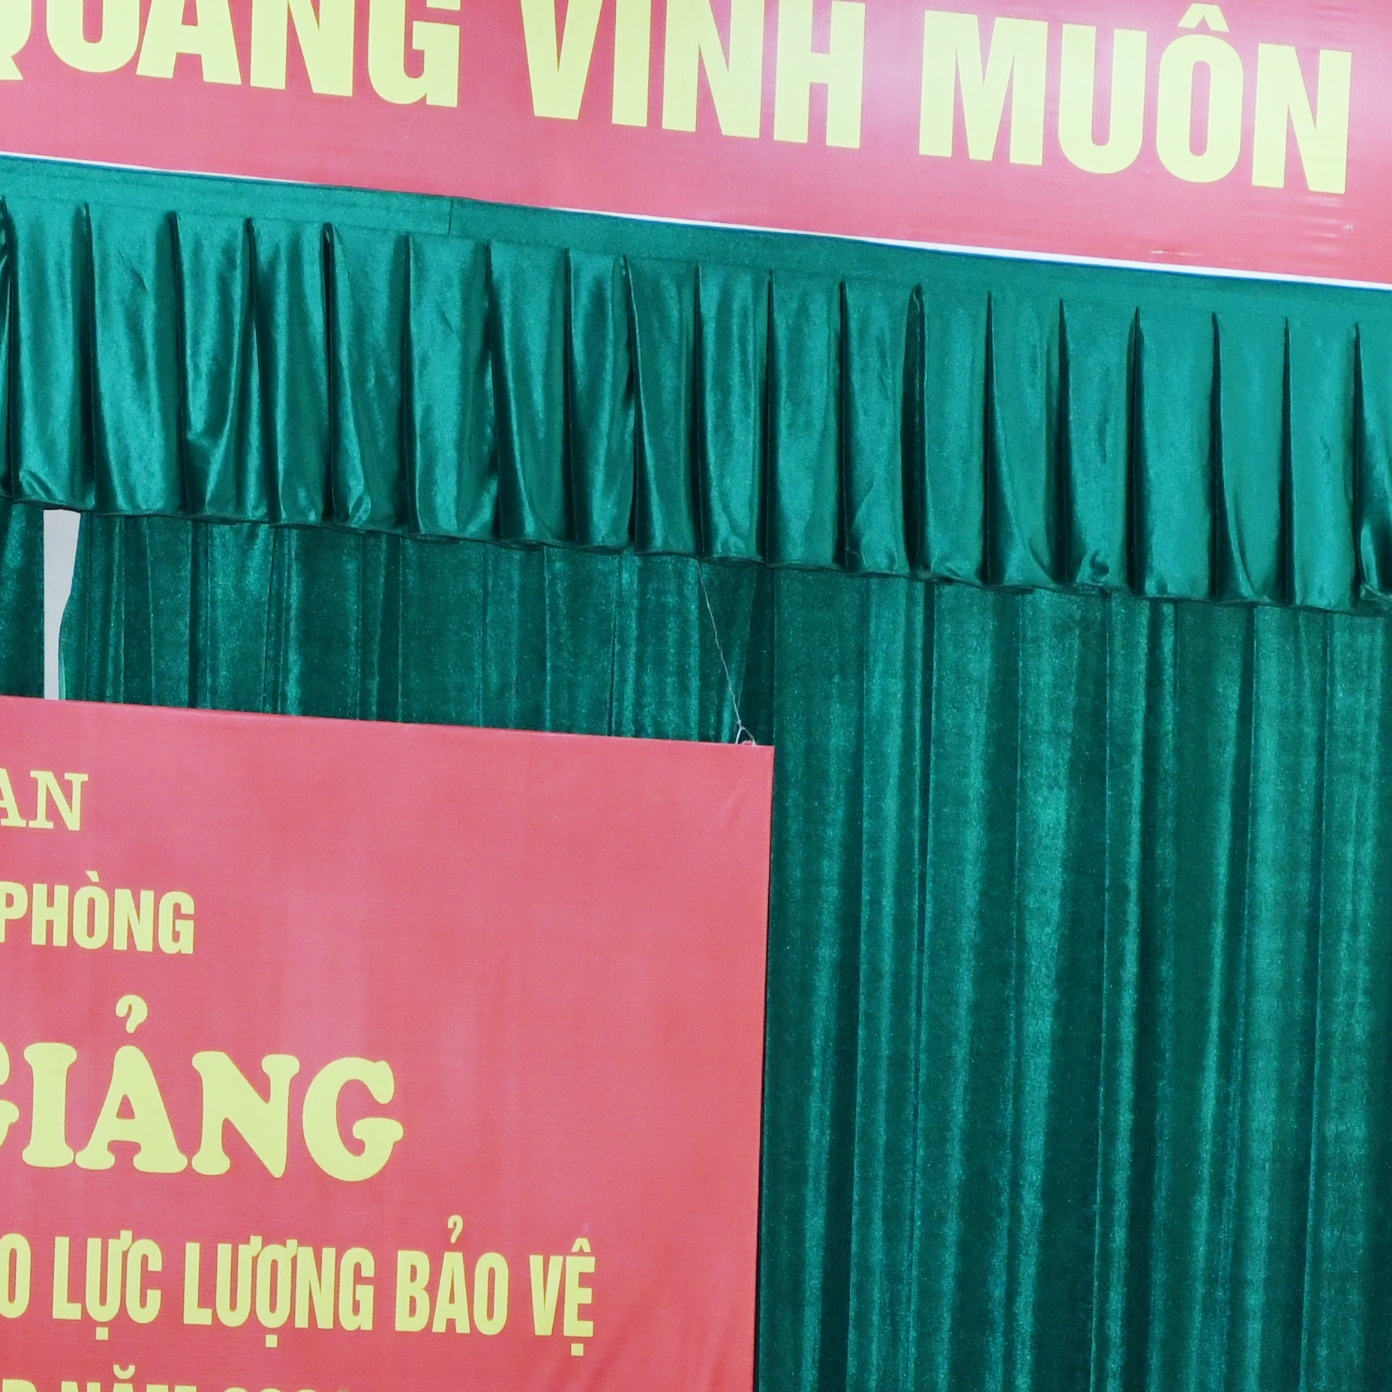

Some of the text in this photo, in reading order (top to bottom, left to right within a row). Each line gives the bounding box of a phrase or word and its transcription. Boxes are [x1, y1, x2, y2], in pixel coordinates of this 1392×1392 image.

[518, 0, 866, 148] VINH
[917, 2, 1352, 194] MUÔN
[51, 1228, 163, 1341] LỰC
[182, 1234, 376, 1349] LƯỢNG
[394, 1213, 510, 1336] BẢO
[528, 1236, 596, 1357] VỆ
